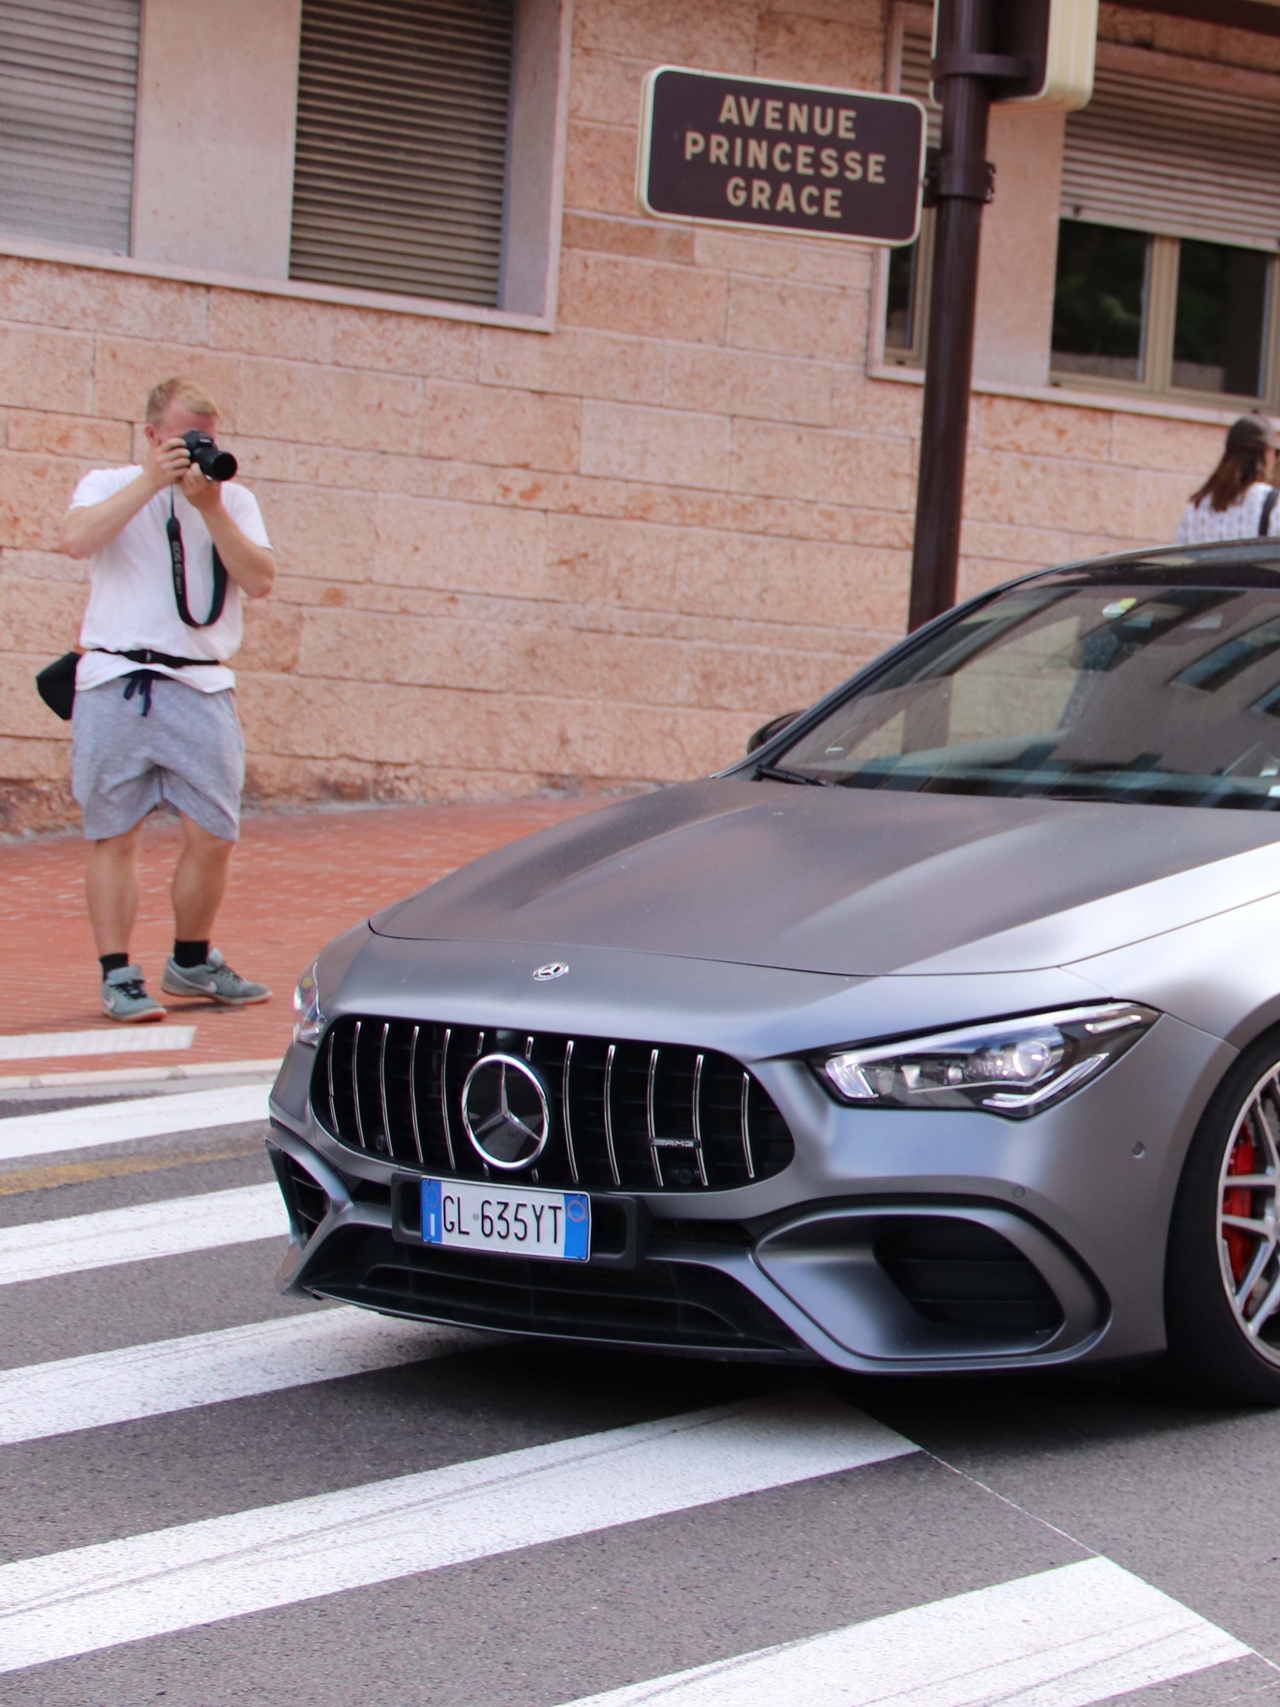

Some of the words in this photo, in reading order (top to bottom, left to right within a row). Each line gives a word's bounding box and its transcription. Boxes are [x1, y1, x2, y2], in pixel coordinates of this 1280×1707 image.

[719, 95, 856, 139] AVENUE
[684, 131, 886, 184] PRINCESSE
[726, 177, 842, 218] GRACE
[443, 1195, 470, 1235] GL
[481, 1200, 562, 1244] 635YT
